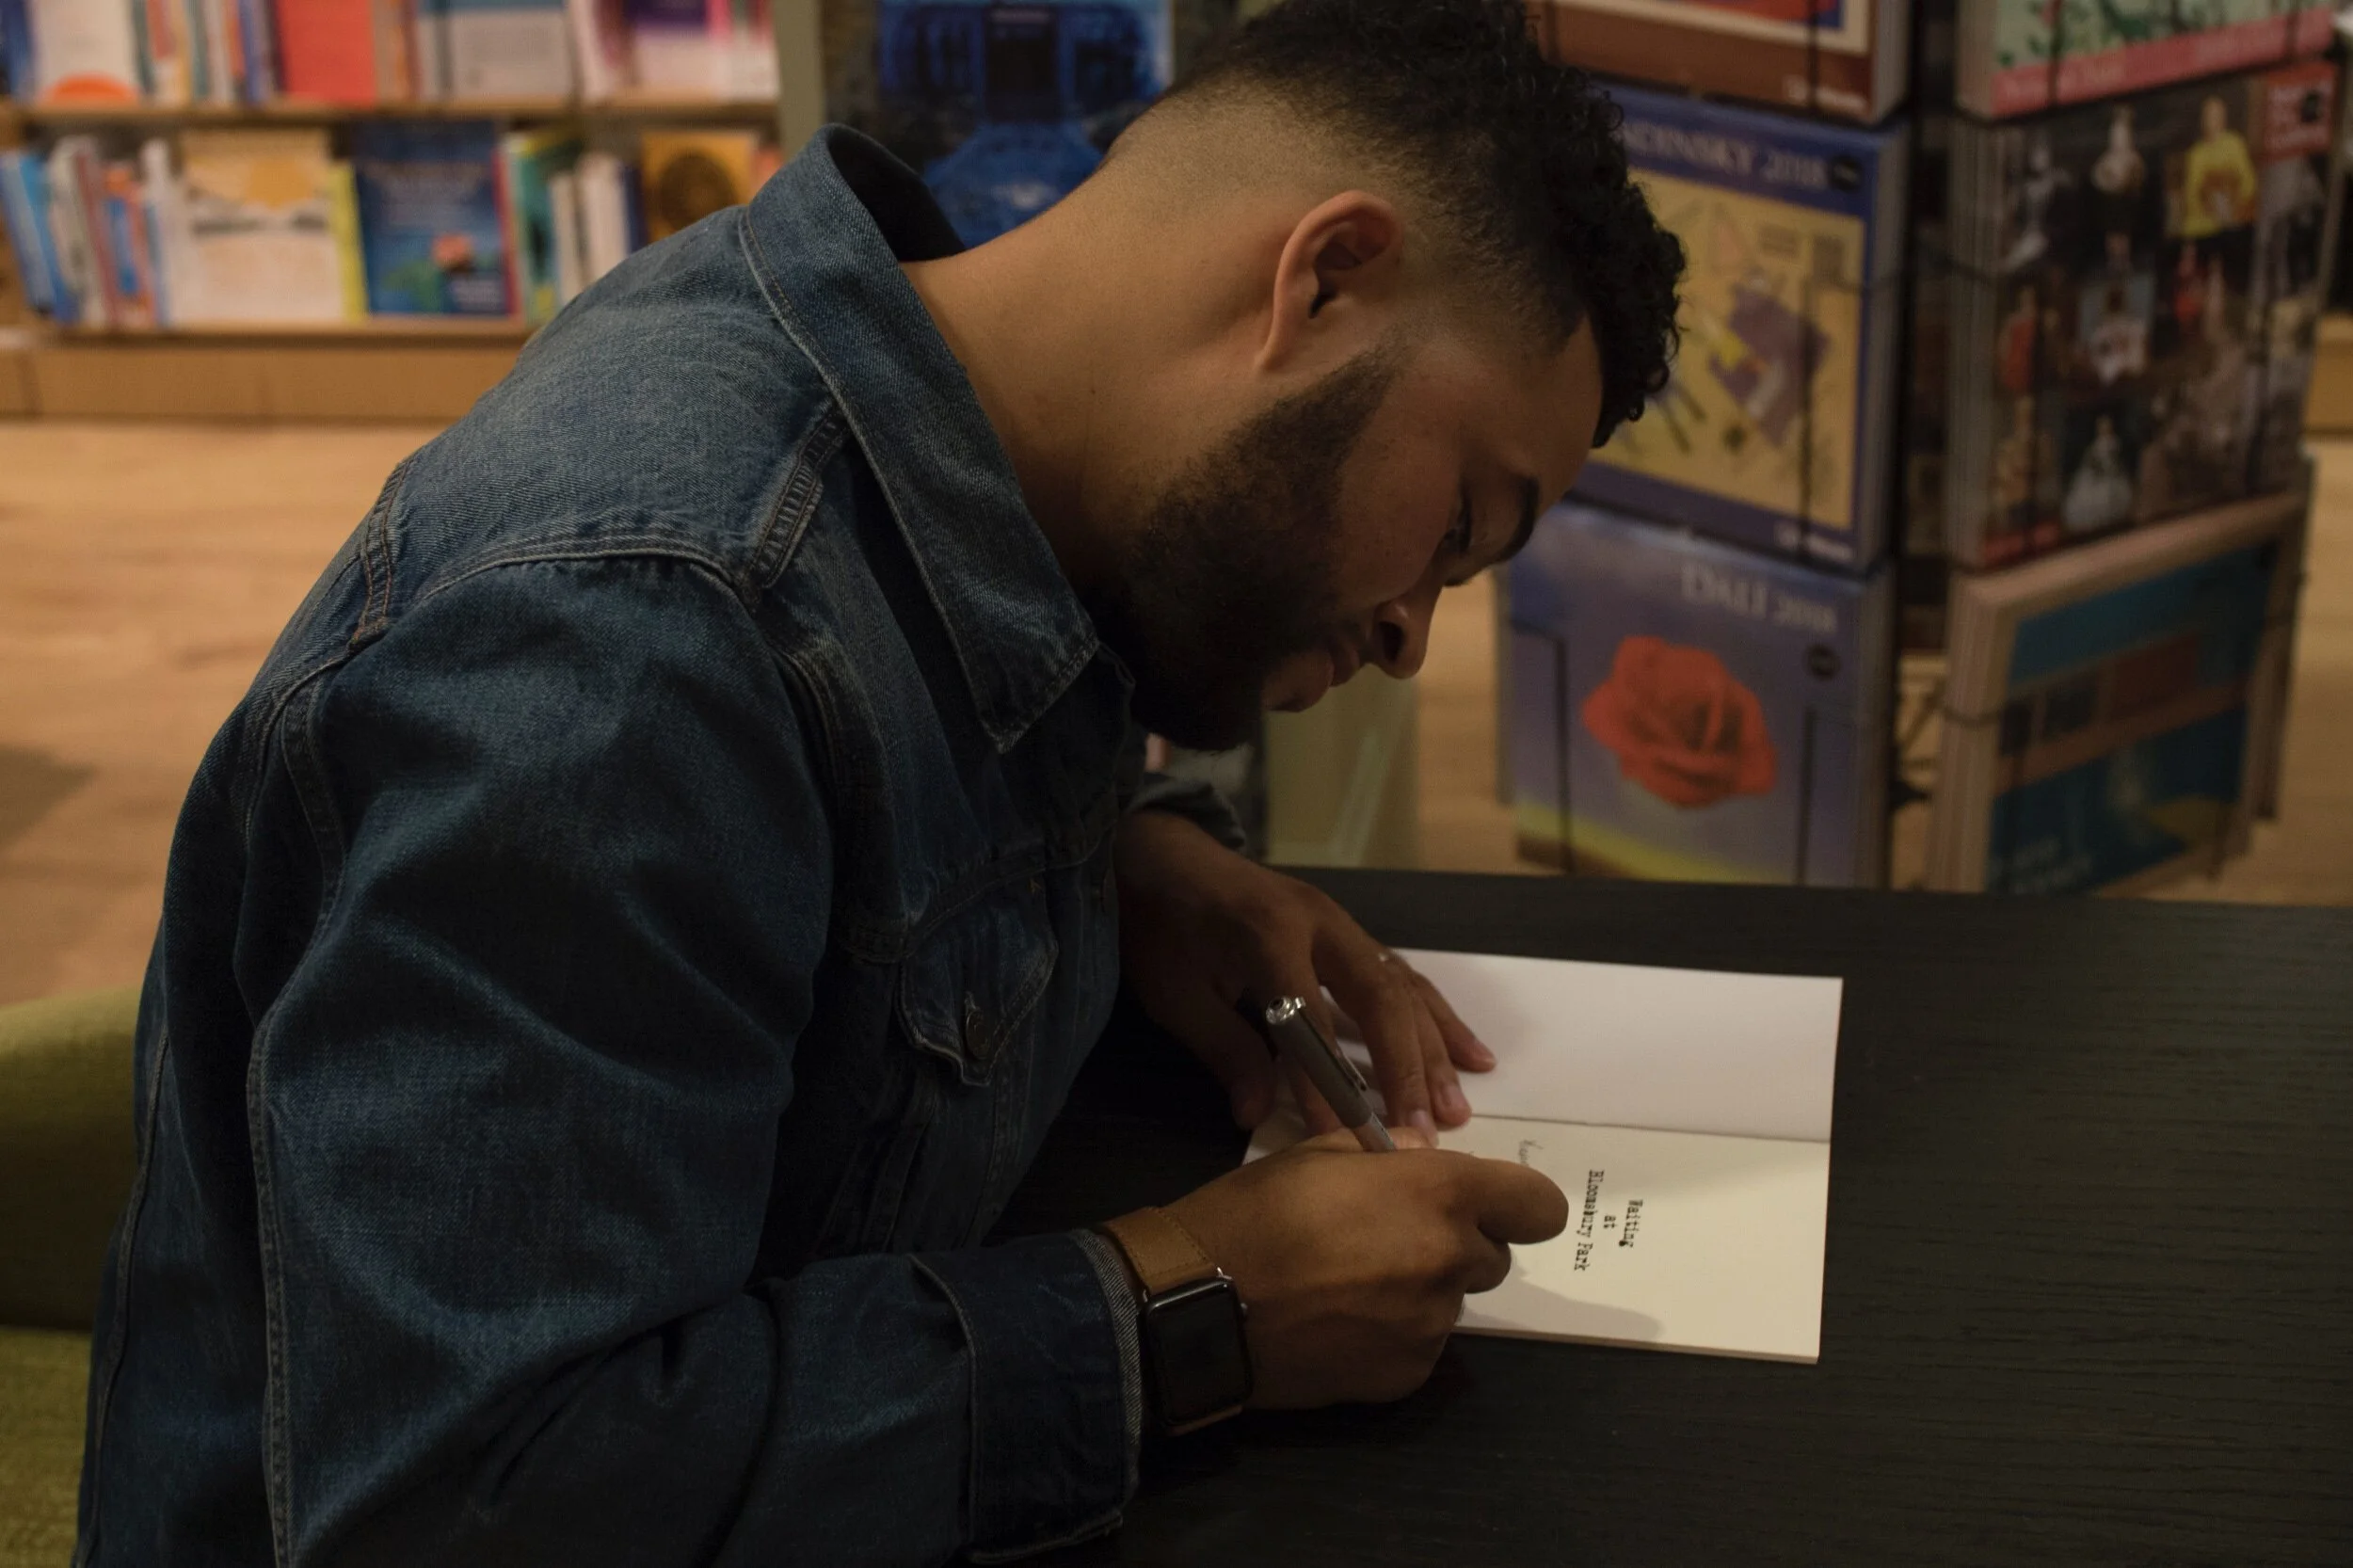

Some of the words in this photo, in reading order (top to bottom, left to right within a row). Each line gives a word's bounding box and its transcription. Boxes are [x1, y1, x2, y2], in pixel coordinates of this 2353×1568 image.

[1577, 1170, 1605, 1238] Bloomsbury
[1603, 1214, 1616, 1229] at
[1618, 1199, 1643, 1248] Waiting
[1574, 1242, 1593, 1272] Park
